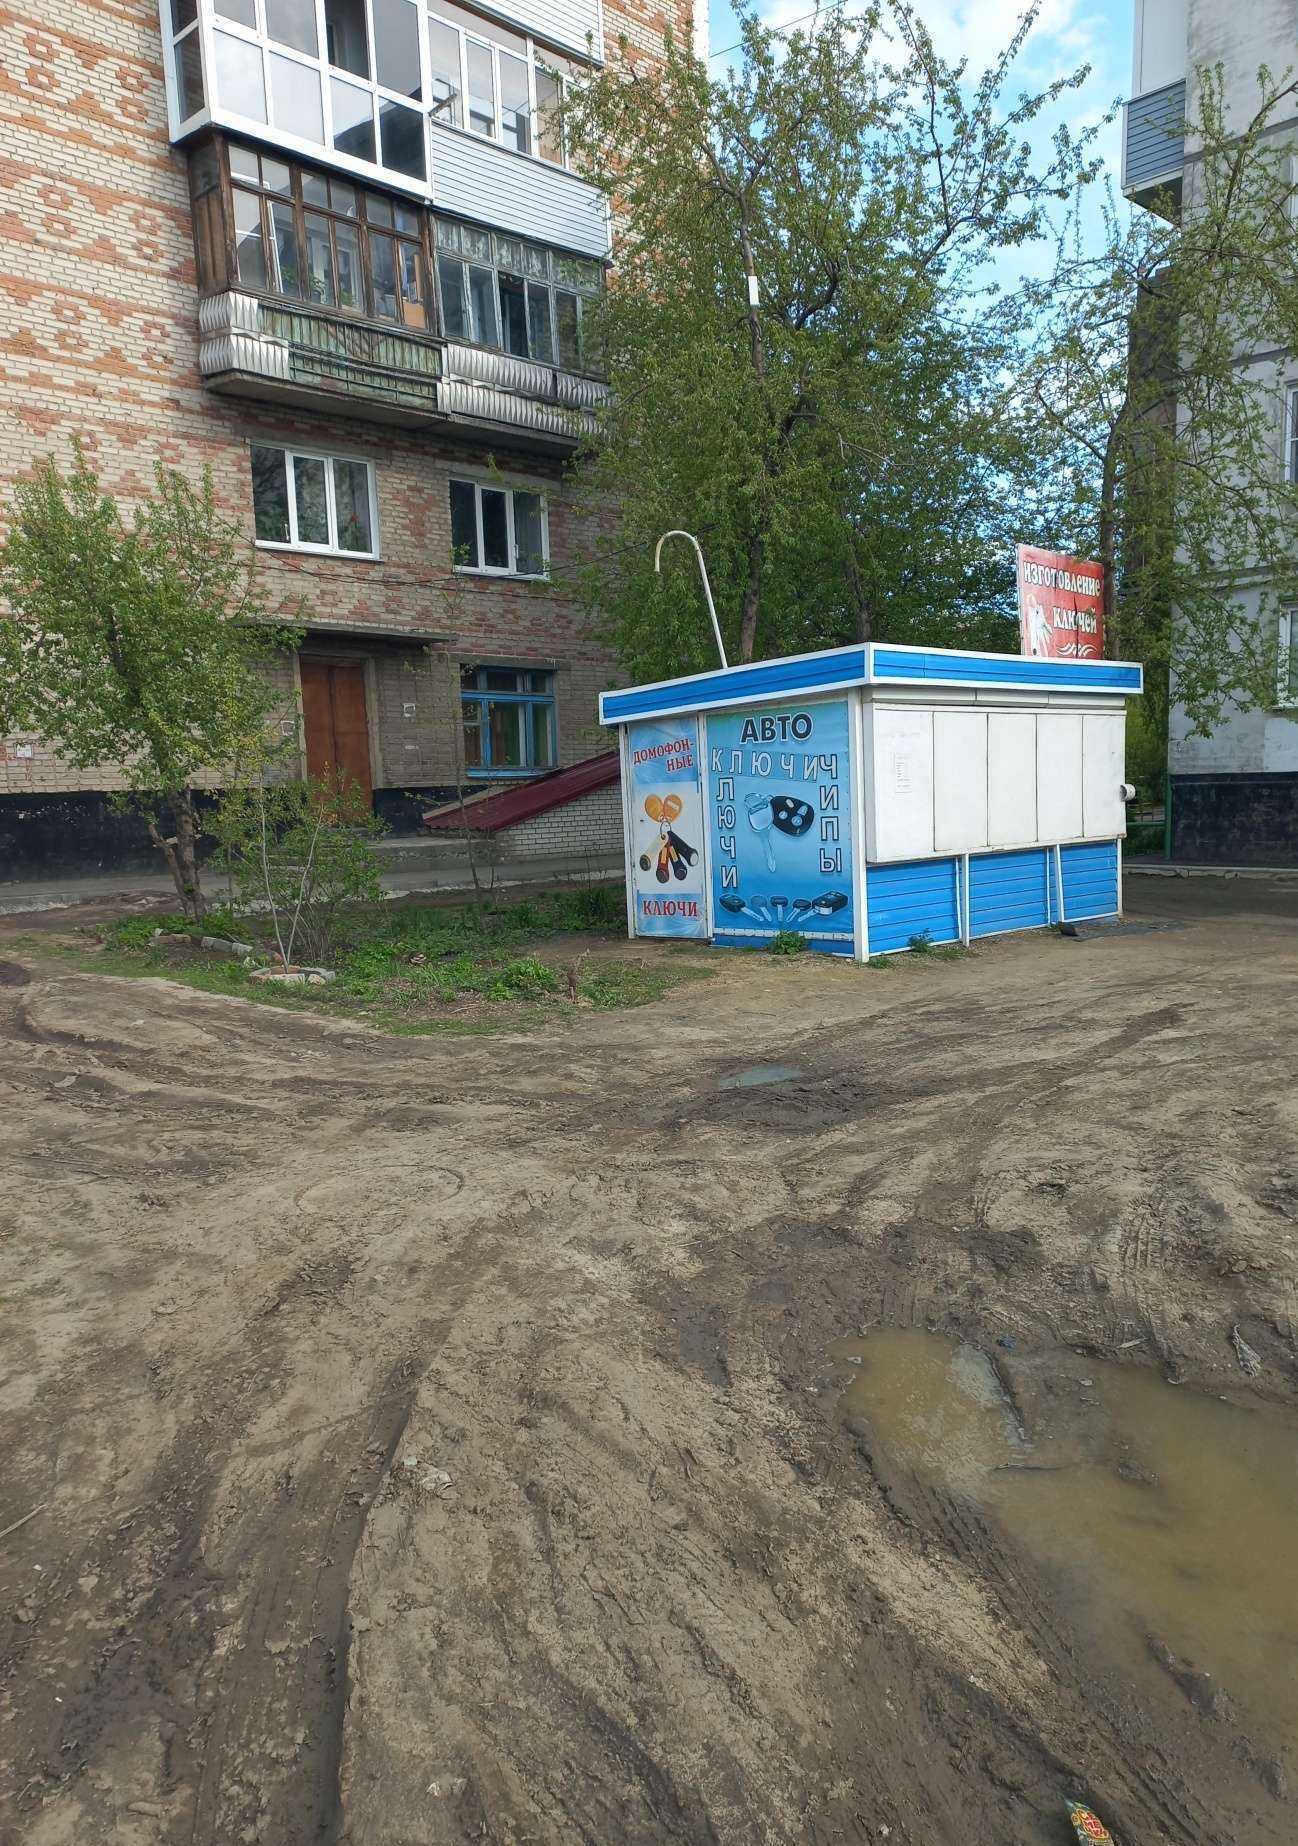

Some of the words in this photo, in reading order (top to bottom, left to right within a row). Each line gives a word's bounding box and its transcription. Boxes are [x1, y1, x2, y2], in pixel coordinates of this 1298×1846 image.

[740, 713, 813, 744] АВТО
[666, 754, 694, 772] НЫЕ
[711, 748, 819, 782] КЛЮЧИ
[818, 754, 843, 873] ЧИПЫ
[643, 900, 698, 917] КЛЮЧИ
